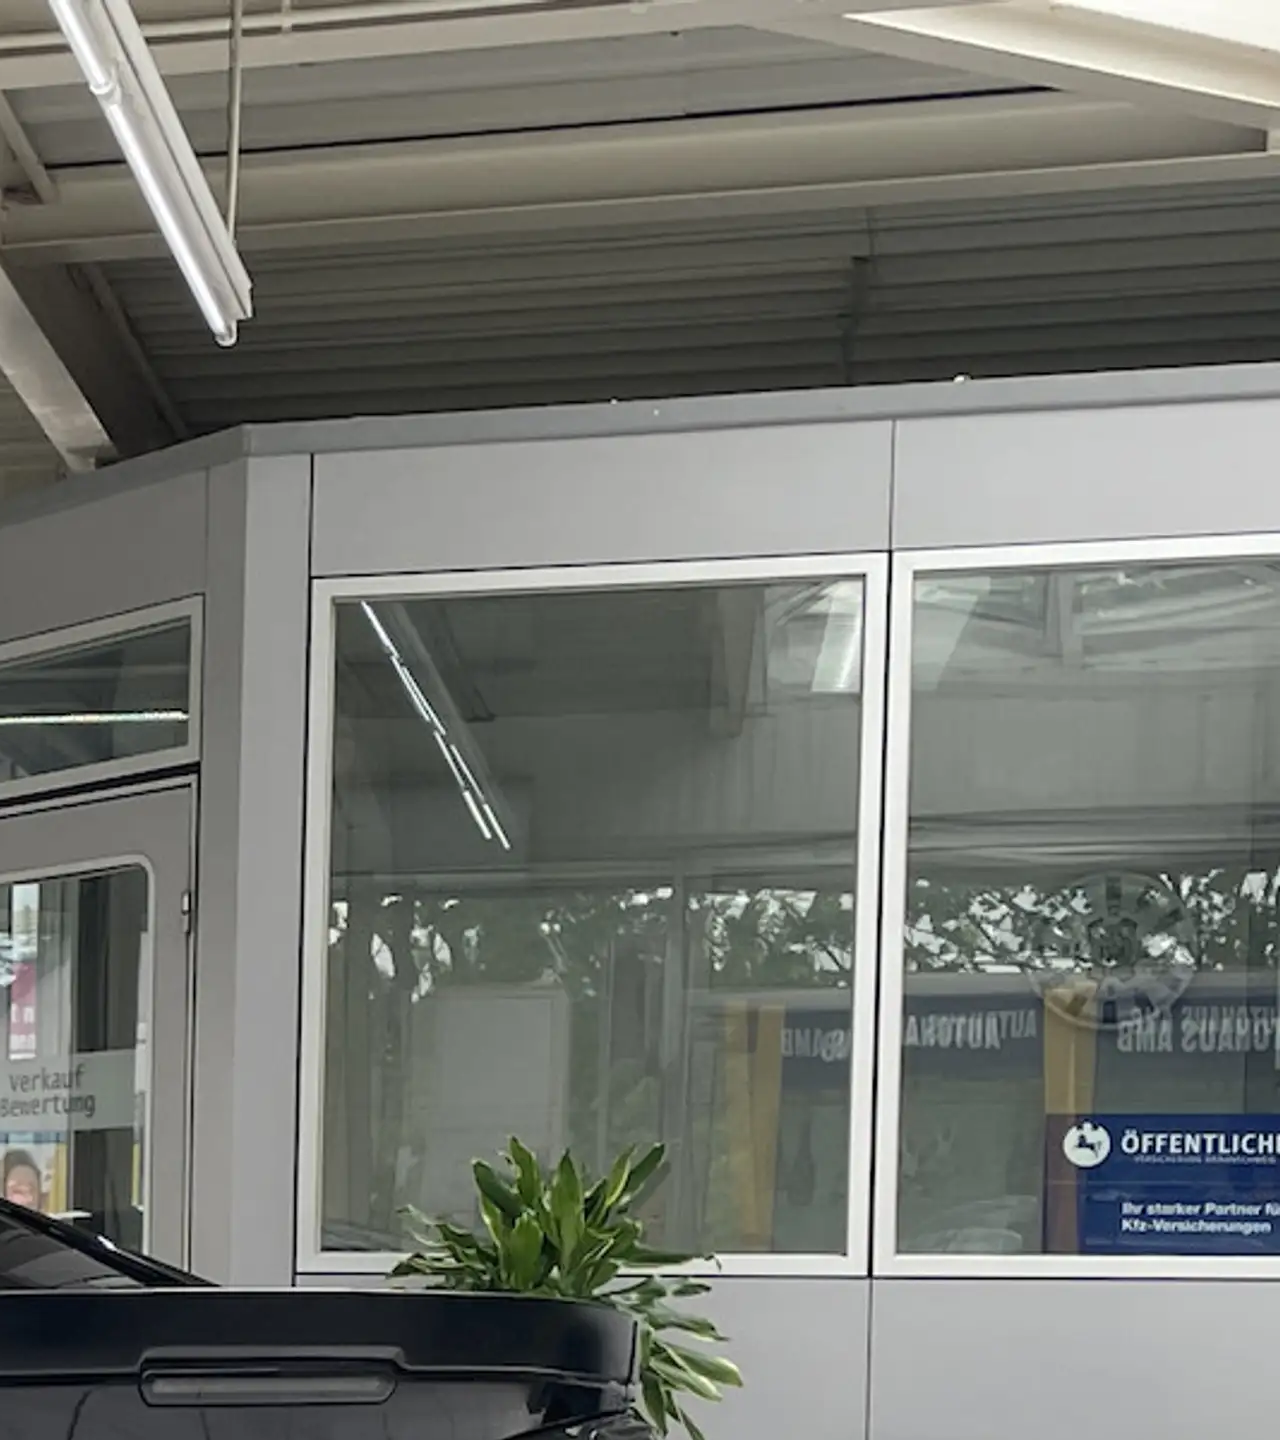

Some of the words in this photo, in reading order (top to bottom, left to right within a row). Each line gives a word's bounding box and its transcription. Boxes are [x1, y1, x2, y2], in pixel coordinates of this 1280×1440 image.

[0, 1093, 96, 1119] Bewertung
[1121, 1202, 1143, 1215] Ihr
[1146, 1202, 1202, 1216] starker
[1203, 1202, 1262, 1216] Partner
[1121, 1219, 1272, 1236] Kfz-Versicherungen
